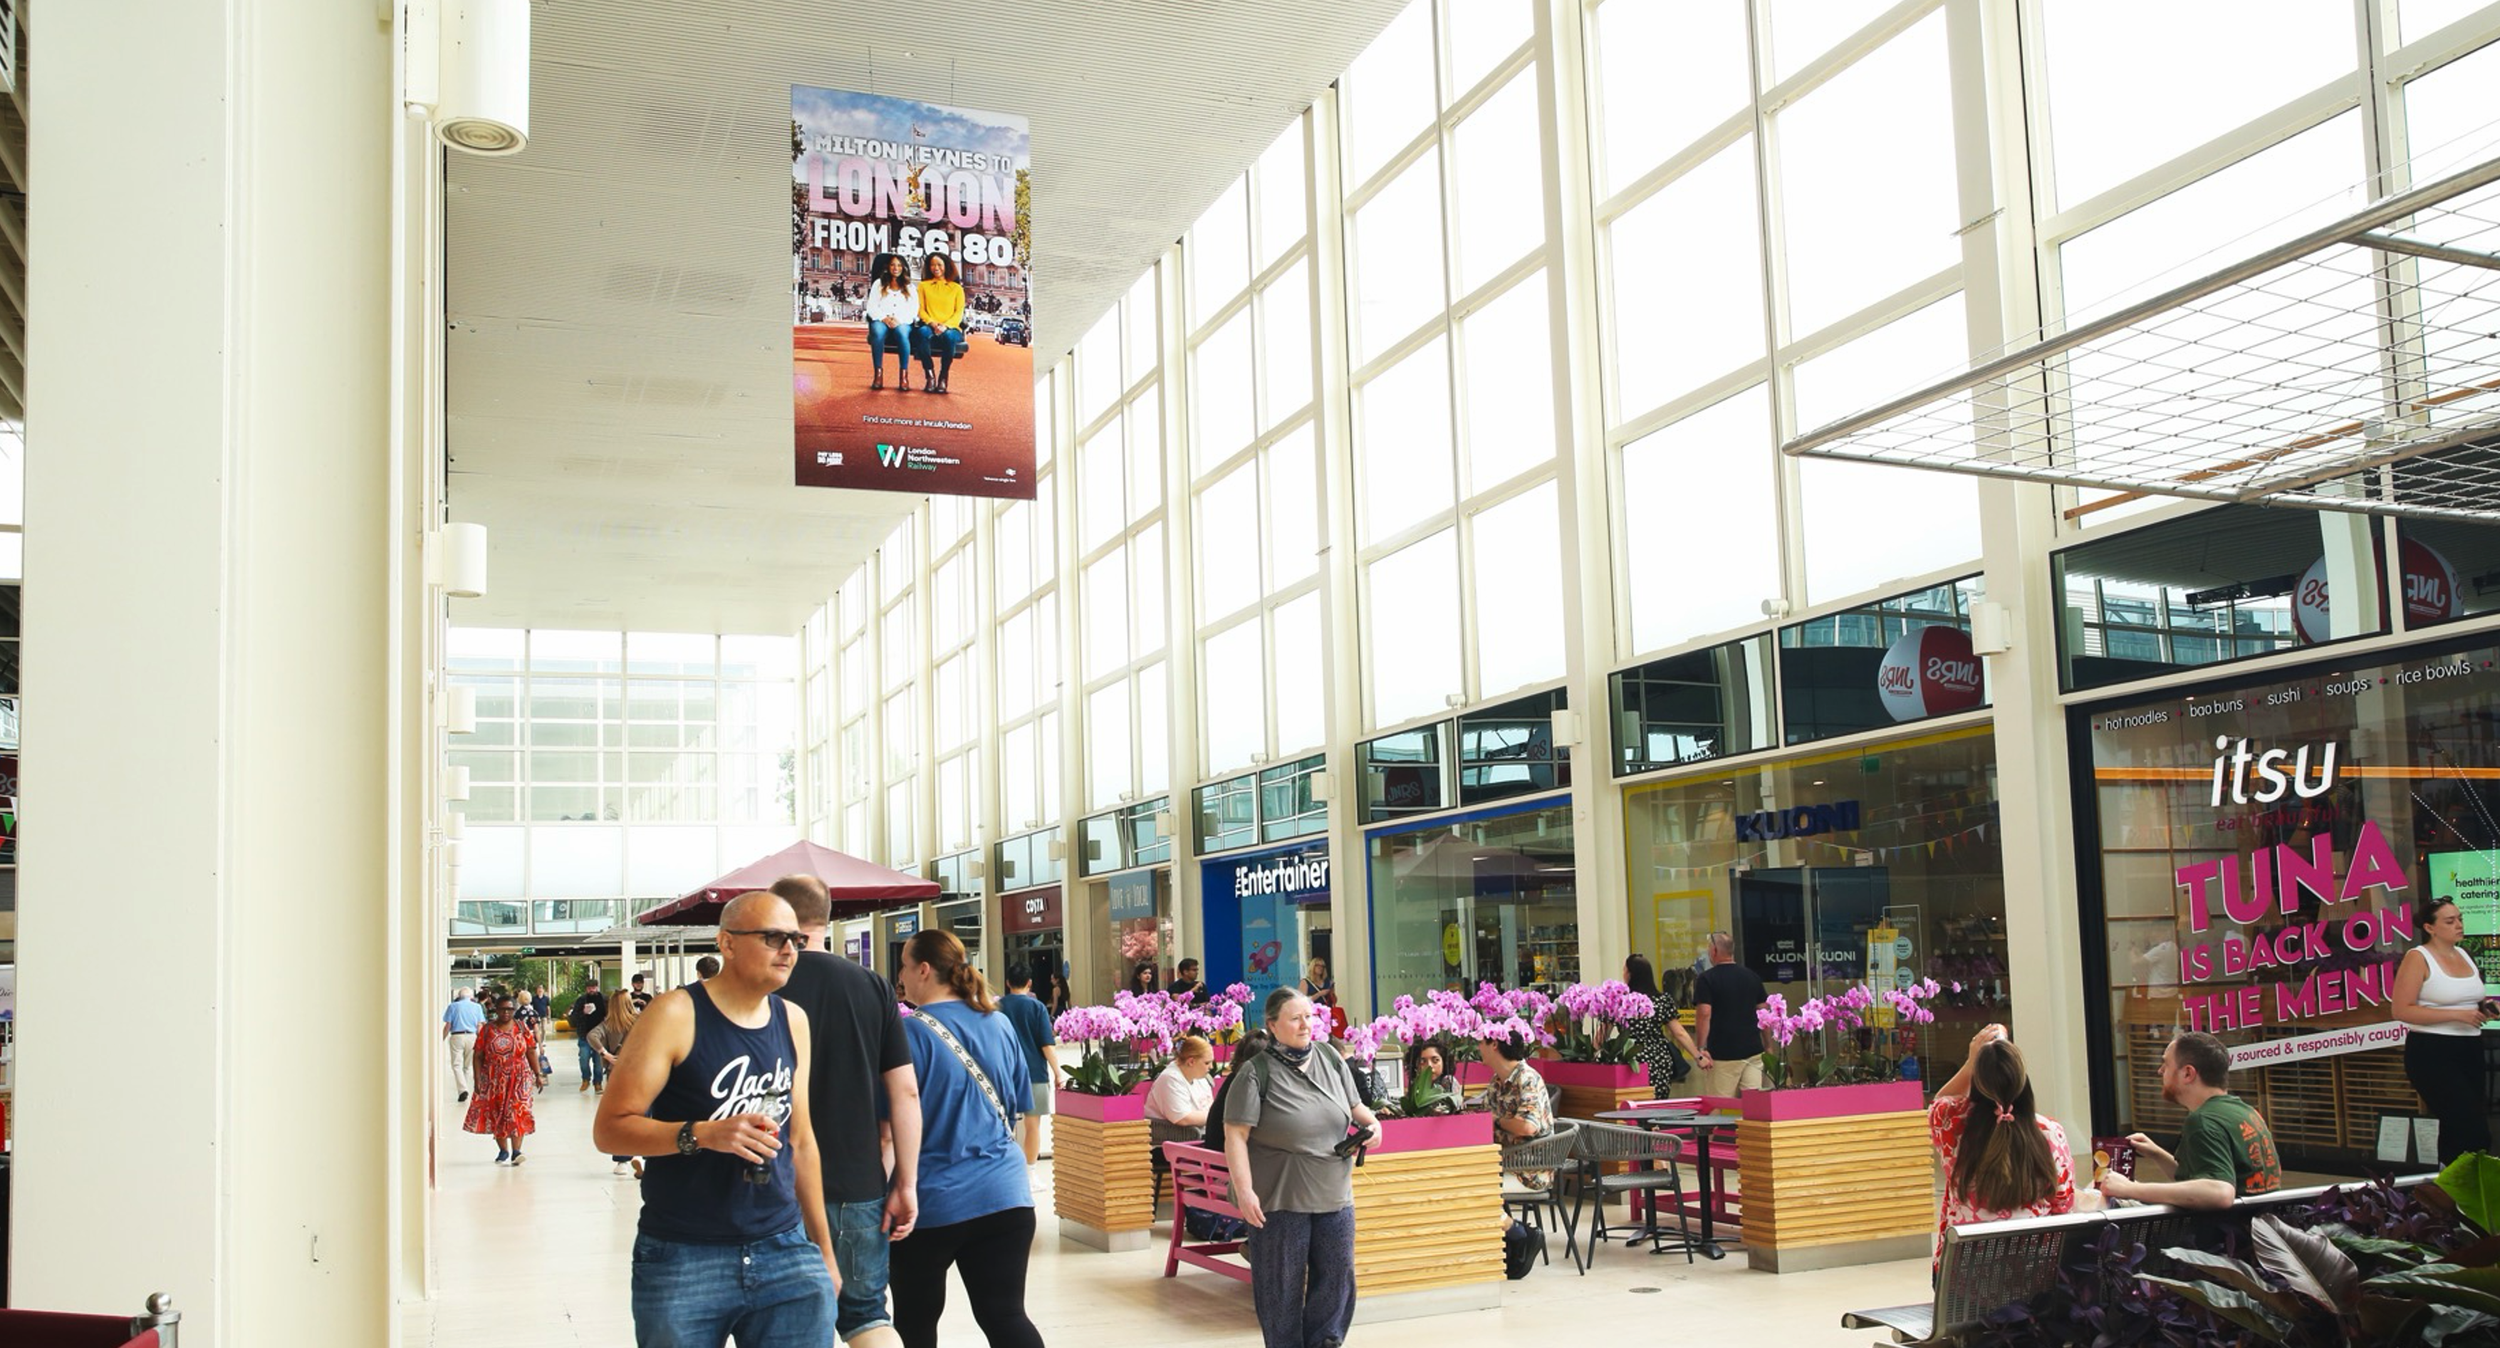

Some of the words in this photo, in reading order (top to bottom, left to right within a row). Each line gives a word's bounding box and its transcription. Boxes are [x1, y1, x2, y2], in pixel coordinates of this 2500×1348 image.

[815, 135, 898, 160] MILTON
[992, 156, 1011, 173] TO
[807, 156, 1017, 232] LONDON
[813, 219, 889, 253] FROM
[896, 226, 1014, 267] £6.80
[863, 415, 878, 423] Find
[880, 417, 892, 425] out
[907, 446, 937, 455] London
[907, 454, 961, 465] Northwestern
[907, 462, 938, 472] Railway
[2105, 716, 2124, 732] hot
[2124, 709, 2169, 729] noodles
[2189, 702, 2213, 718] bao
[2213, 698, 2243, 715] buns
[2267, 687, 2301, 706] sushi
[2326, 678, 2368, 697] soups
[2395, 668, 2422, 686] rice
[2426, 659, 2471, 681] bowls
[2210, 734, 2337, 808] itsu
[1387, 781, 1421, 802] JNRS
[1736, 800, 1861, 843] KUONI
[2216, 815, 2244, 832] eat
[1240, 855, 1328, 897] Entertainer
[2175, 819, 2410, 934] TUNA
[2460, 890, 2500, 900] catering
[1765, 952, 1807, 963] KUON
[1818, 950, 1856, 962] KUONI
[2180, 943, 2214, 985] IS
[2222, 919, 2333, 977] BACK
[2342, 902, 2415, 954] ON
[2182, 985, 2265, 1034] THE
[2236, 1040, 2282, 1063] sourced
[2284, 1042, 2295, 1055] &
[2297, 1031, 2366, 1056] responsibly
[2368, 1023, 2410, 1042] caugh
